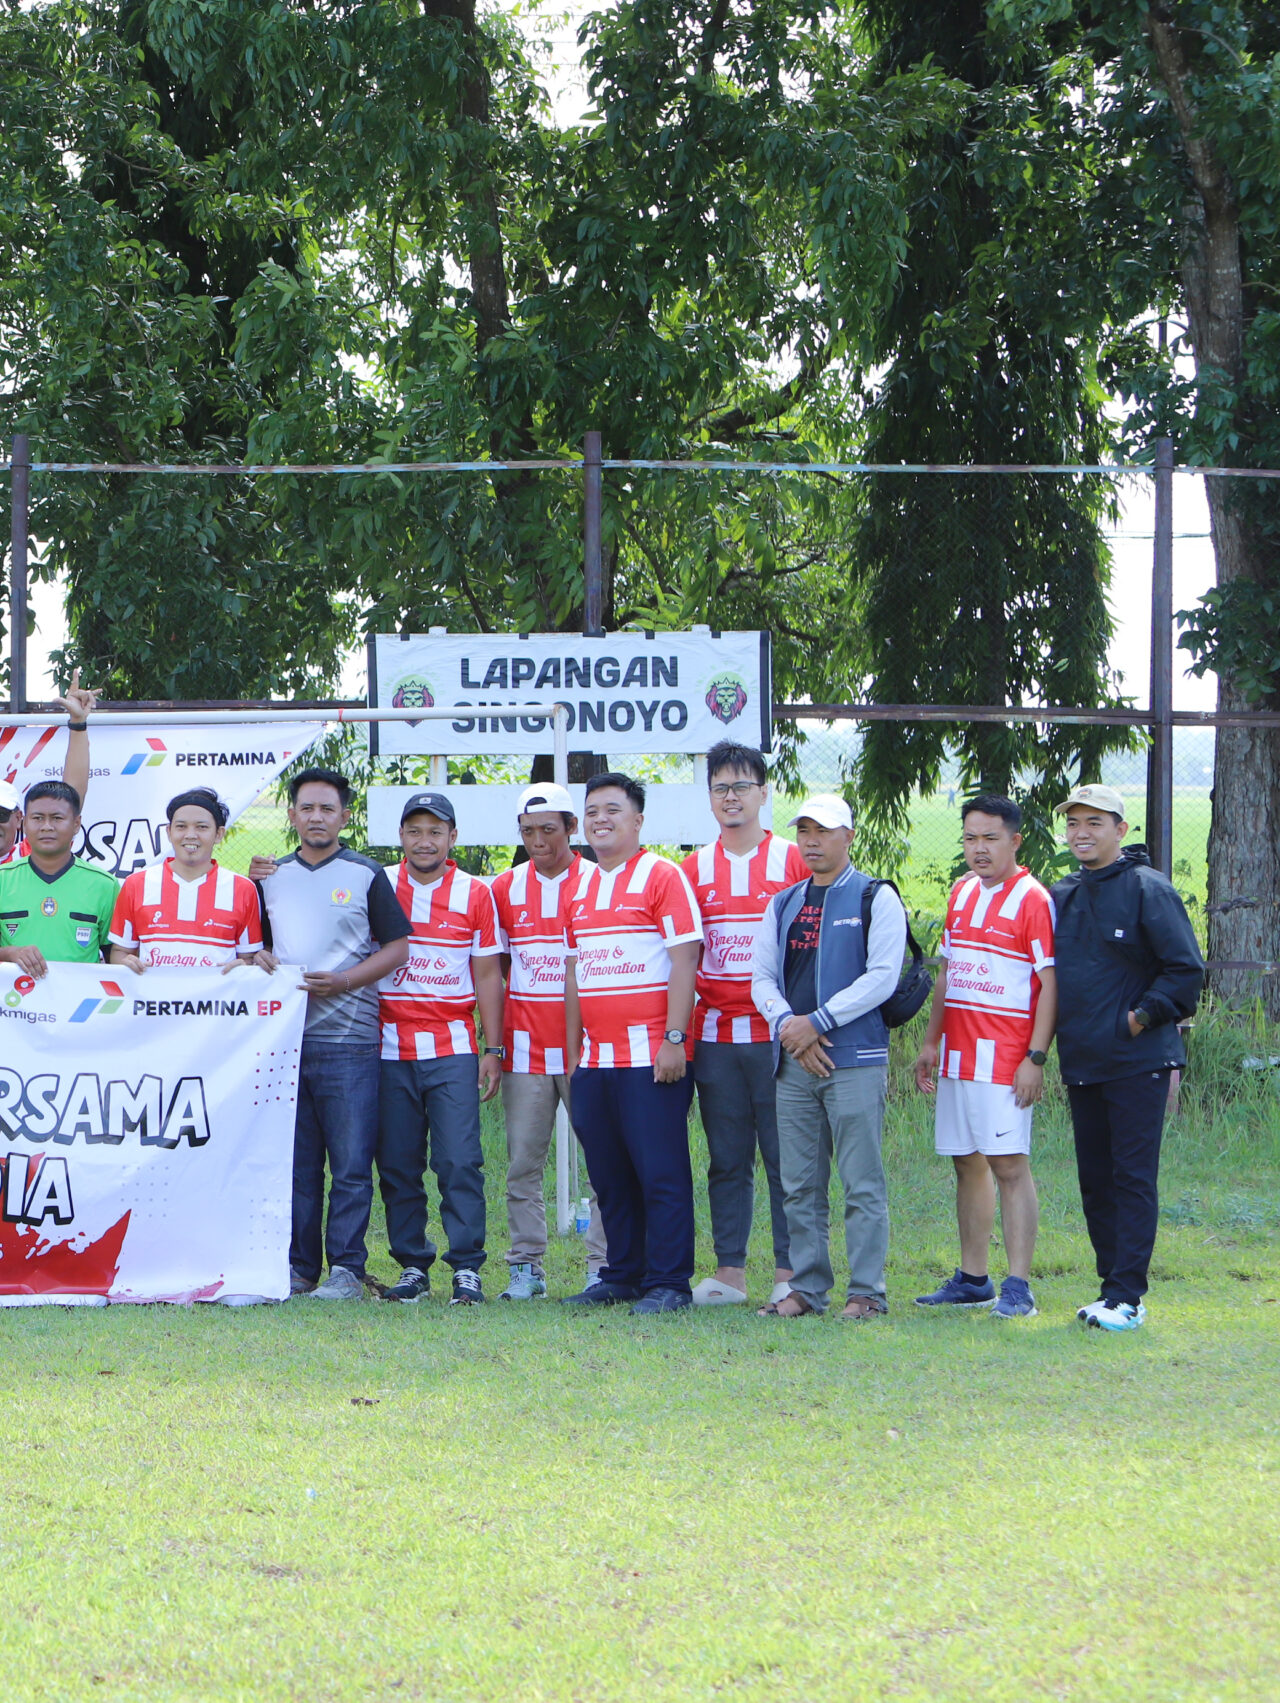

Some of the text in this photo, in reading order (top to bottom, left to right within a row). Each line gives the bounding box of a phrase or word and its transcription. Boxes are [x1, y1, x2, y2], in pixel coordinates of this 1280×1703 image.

[460, 656, 678, 689] LAPANGAN
[176, 752, 276, 766] PERTAMINA
[612, 946, 625, 959] &
[434, 957, 447, 970] &
[582, 960, 646, 982] Innovation
[976, 962, 990, 976] &
[393, 966, 460, 987] Innovation
[133, 1000, 282, 1016] PERTAMINA EP
